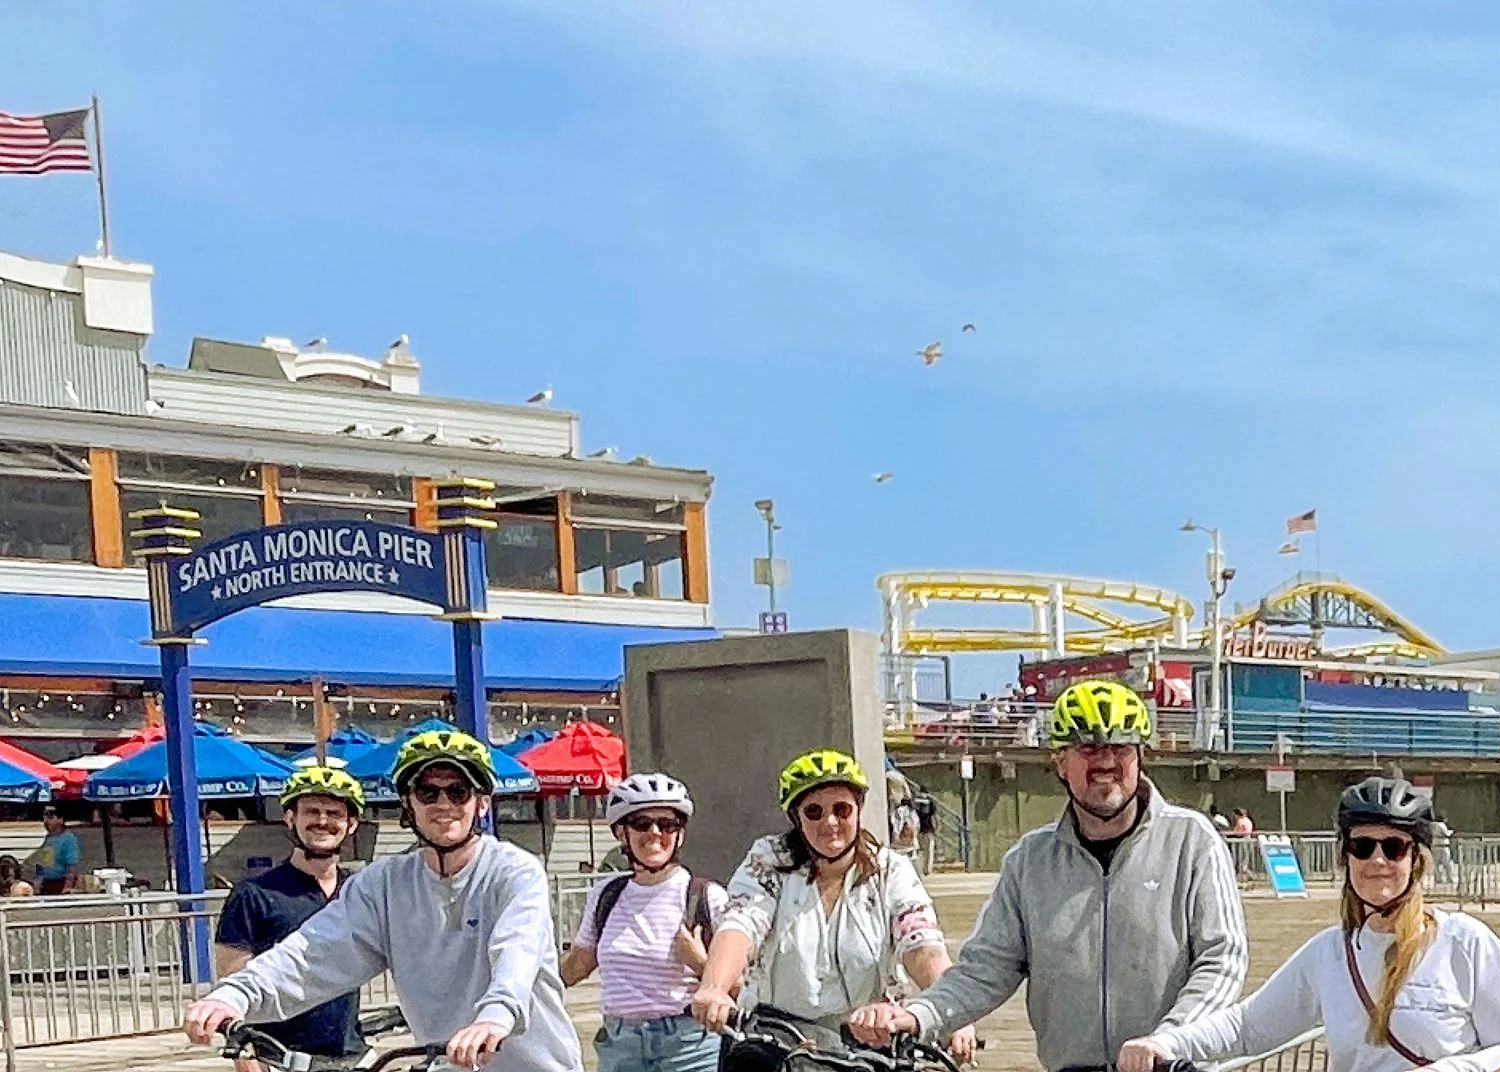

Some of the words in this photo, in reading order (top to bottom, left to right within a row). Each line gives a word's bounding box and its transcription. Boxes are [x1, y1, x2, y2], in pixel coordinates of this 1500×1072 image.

[178, 540, 258, 593] SANTA
[263, 527, 372, 563] MONICA
[378, 532, 435, 569] PIER
[224, 567, 286, 599] NORTH
[290, 561, 385, 585] ENTRANCE
